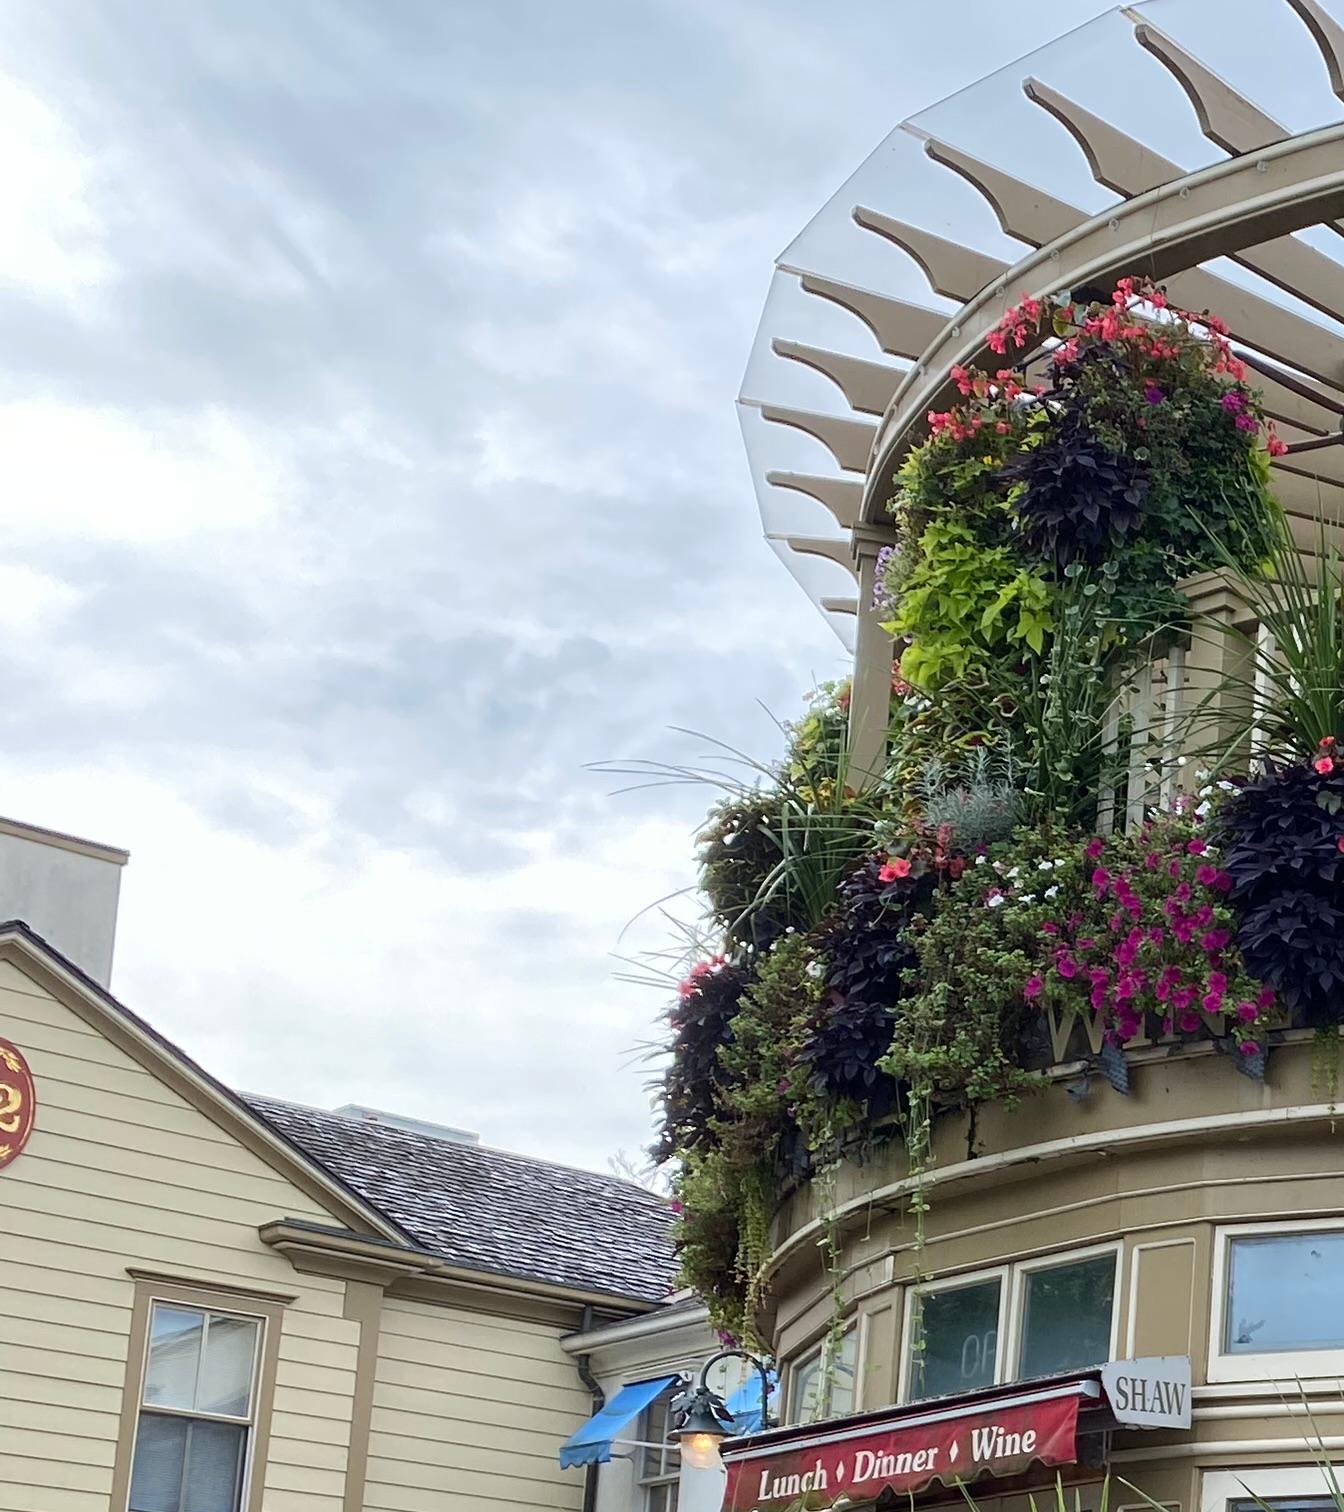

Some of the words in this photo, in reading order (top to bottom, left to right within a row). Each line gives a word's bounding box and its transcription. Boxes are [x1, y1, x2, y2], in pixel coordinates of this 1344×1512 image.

[1116, 1376, 1187, 1416] SHAW
[758, 1459, 828, 1501] Lunch
[852, 1448, 939, 1483] Dinner
[971, 1426, 1037, 1462] Wine
